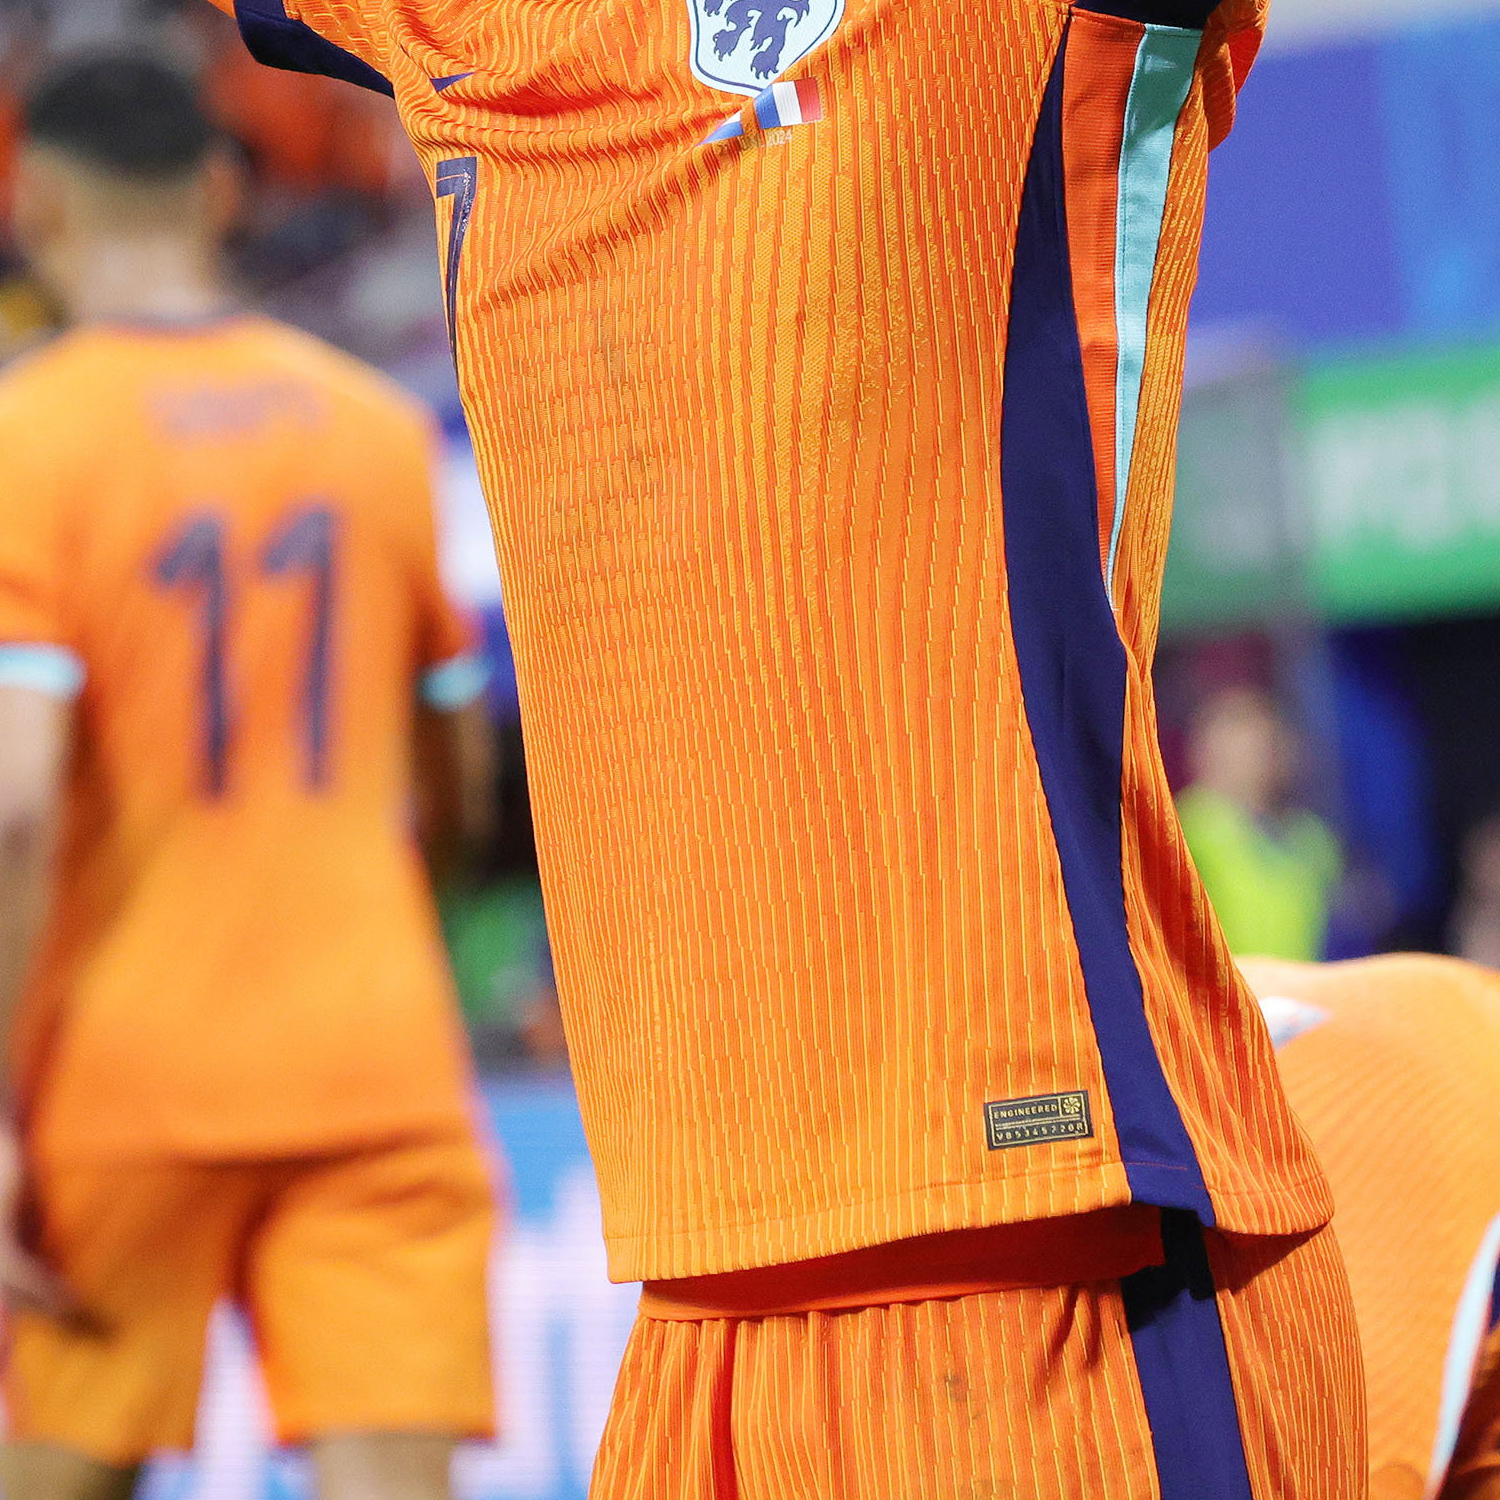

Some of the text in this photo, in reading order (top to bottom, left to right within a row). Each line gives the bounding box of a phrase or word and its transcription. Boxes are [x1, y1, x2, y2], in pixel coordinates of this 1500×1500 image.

[436, 155, 478, 370] 7
[153, 502, 340, 799] 11
[993, 1103, 1058, 1119] ENGINEERED
